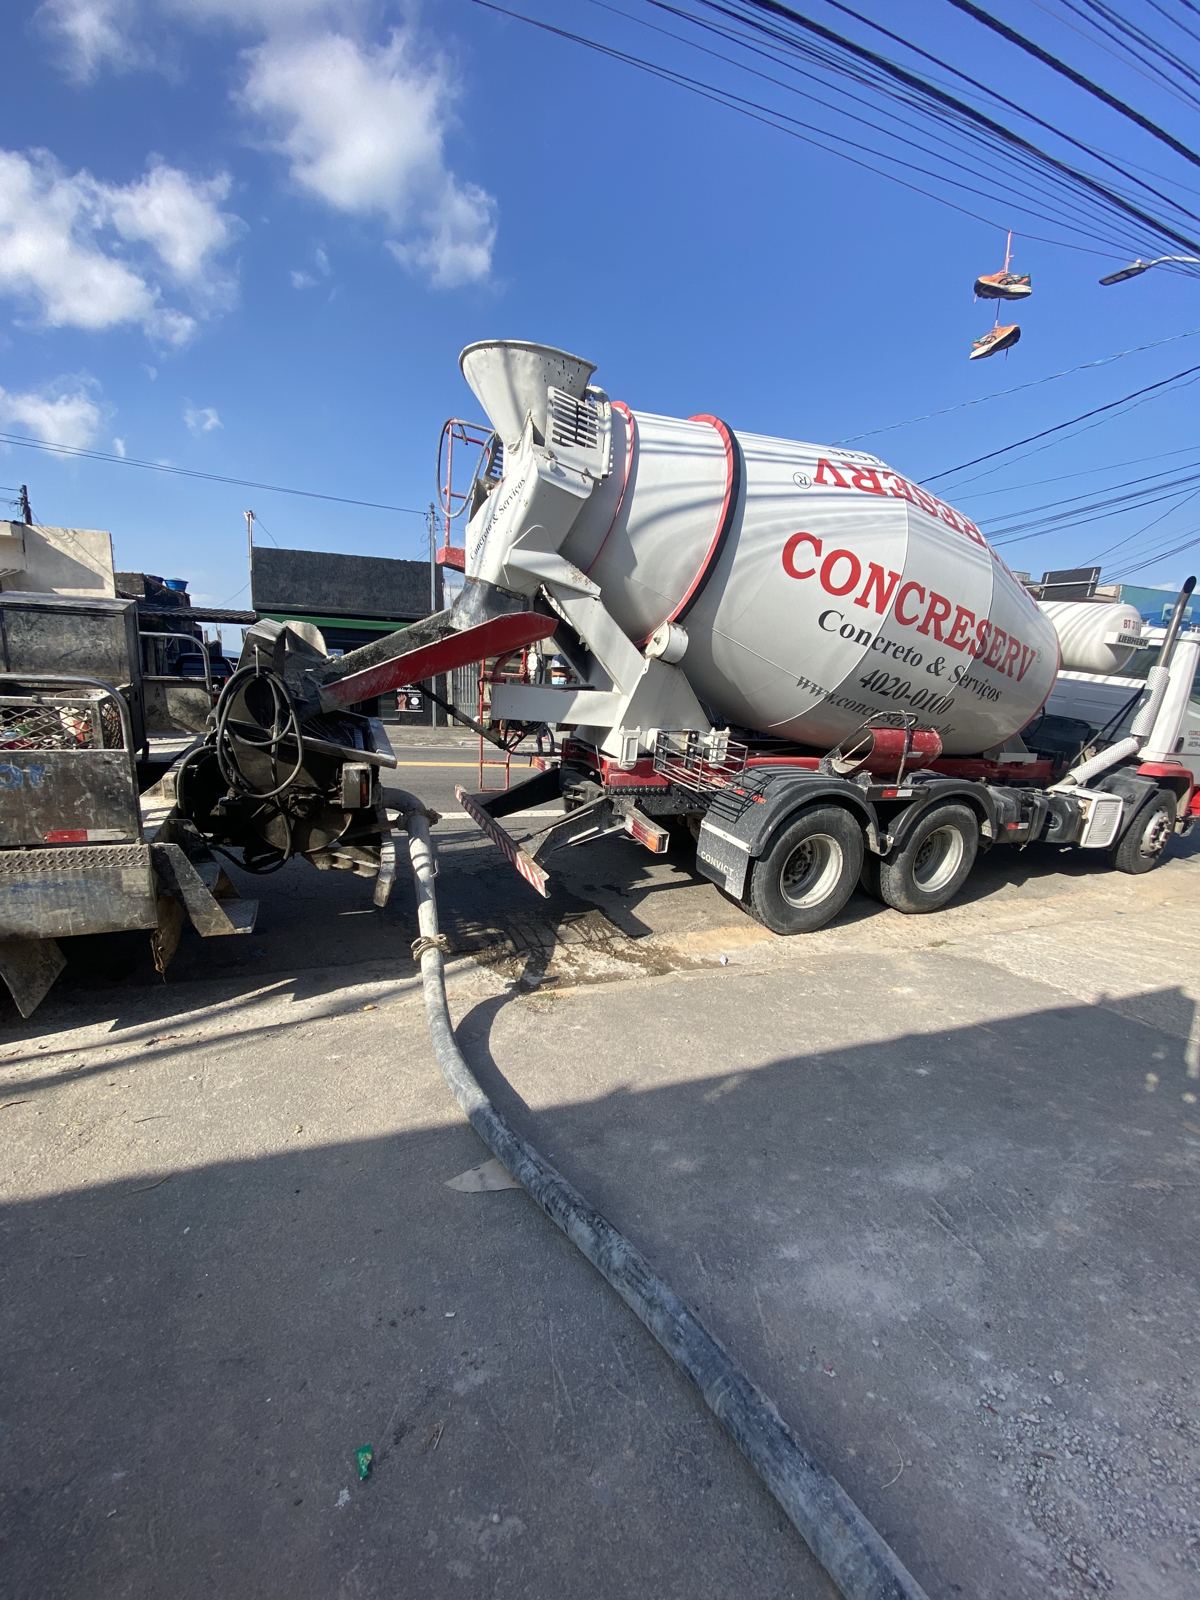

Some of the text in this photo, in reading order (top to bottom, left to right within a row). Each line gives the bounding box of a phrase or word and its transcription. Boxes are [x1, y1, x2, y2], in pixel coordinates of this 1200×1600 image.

[498, 478, 526, 515] Serviços
[813, 457, 998, 560] RESERV
[781, 531, 1038, 683] CONCRESERV
[818, 609, 1004, 703] Concreto & Serviços
[1118, 634, 1149, 647] LIEBHERR
[859, 668, 955, 716] 4020-0100
[700, 850, 735, 877] CONVICT
